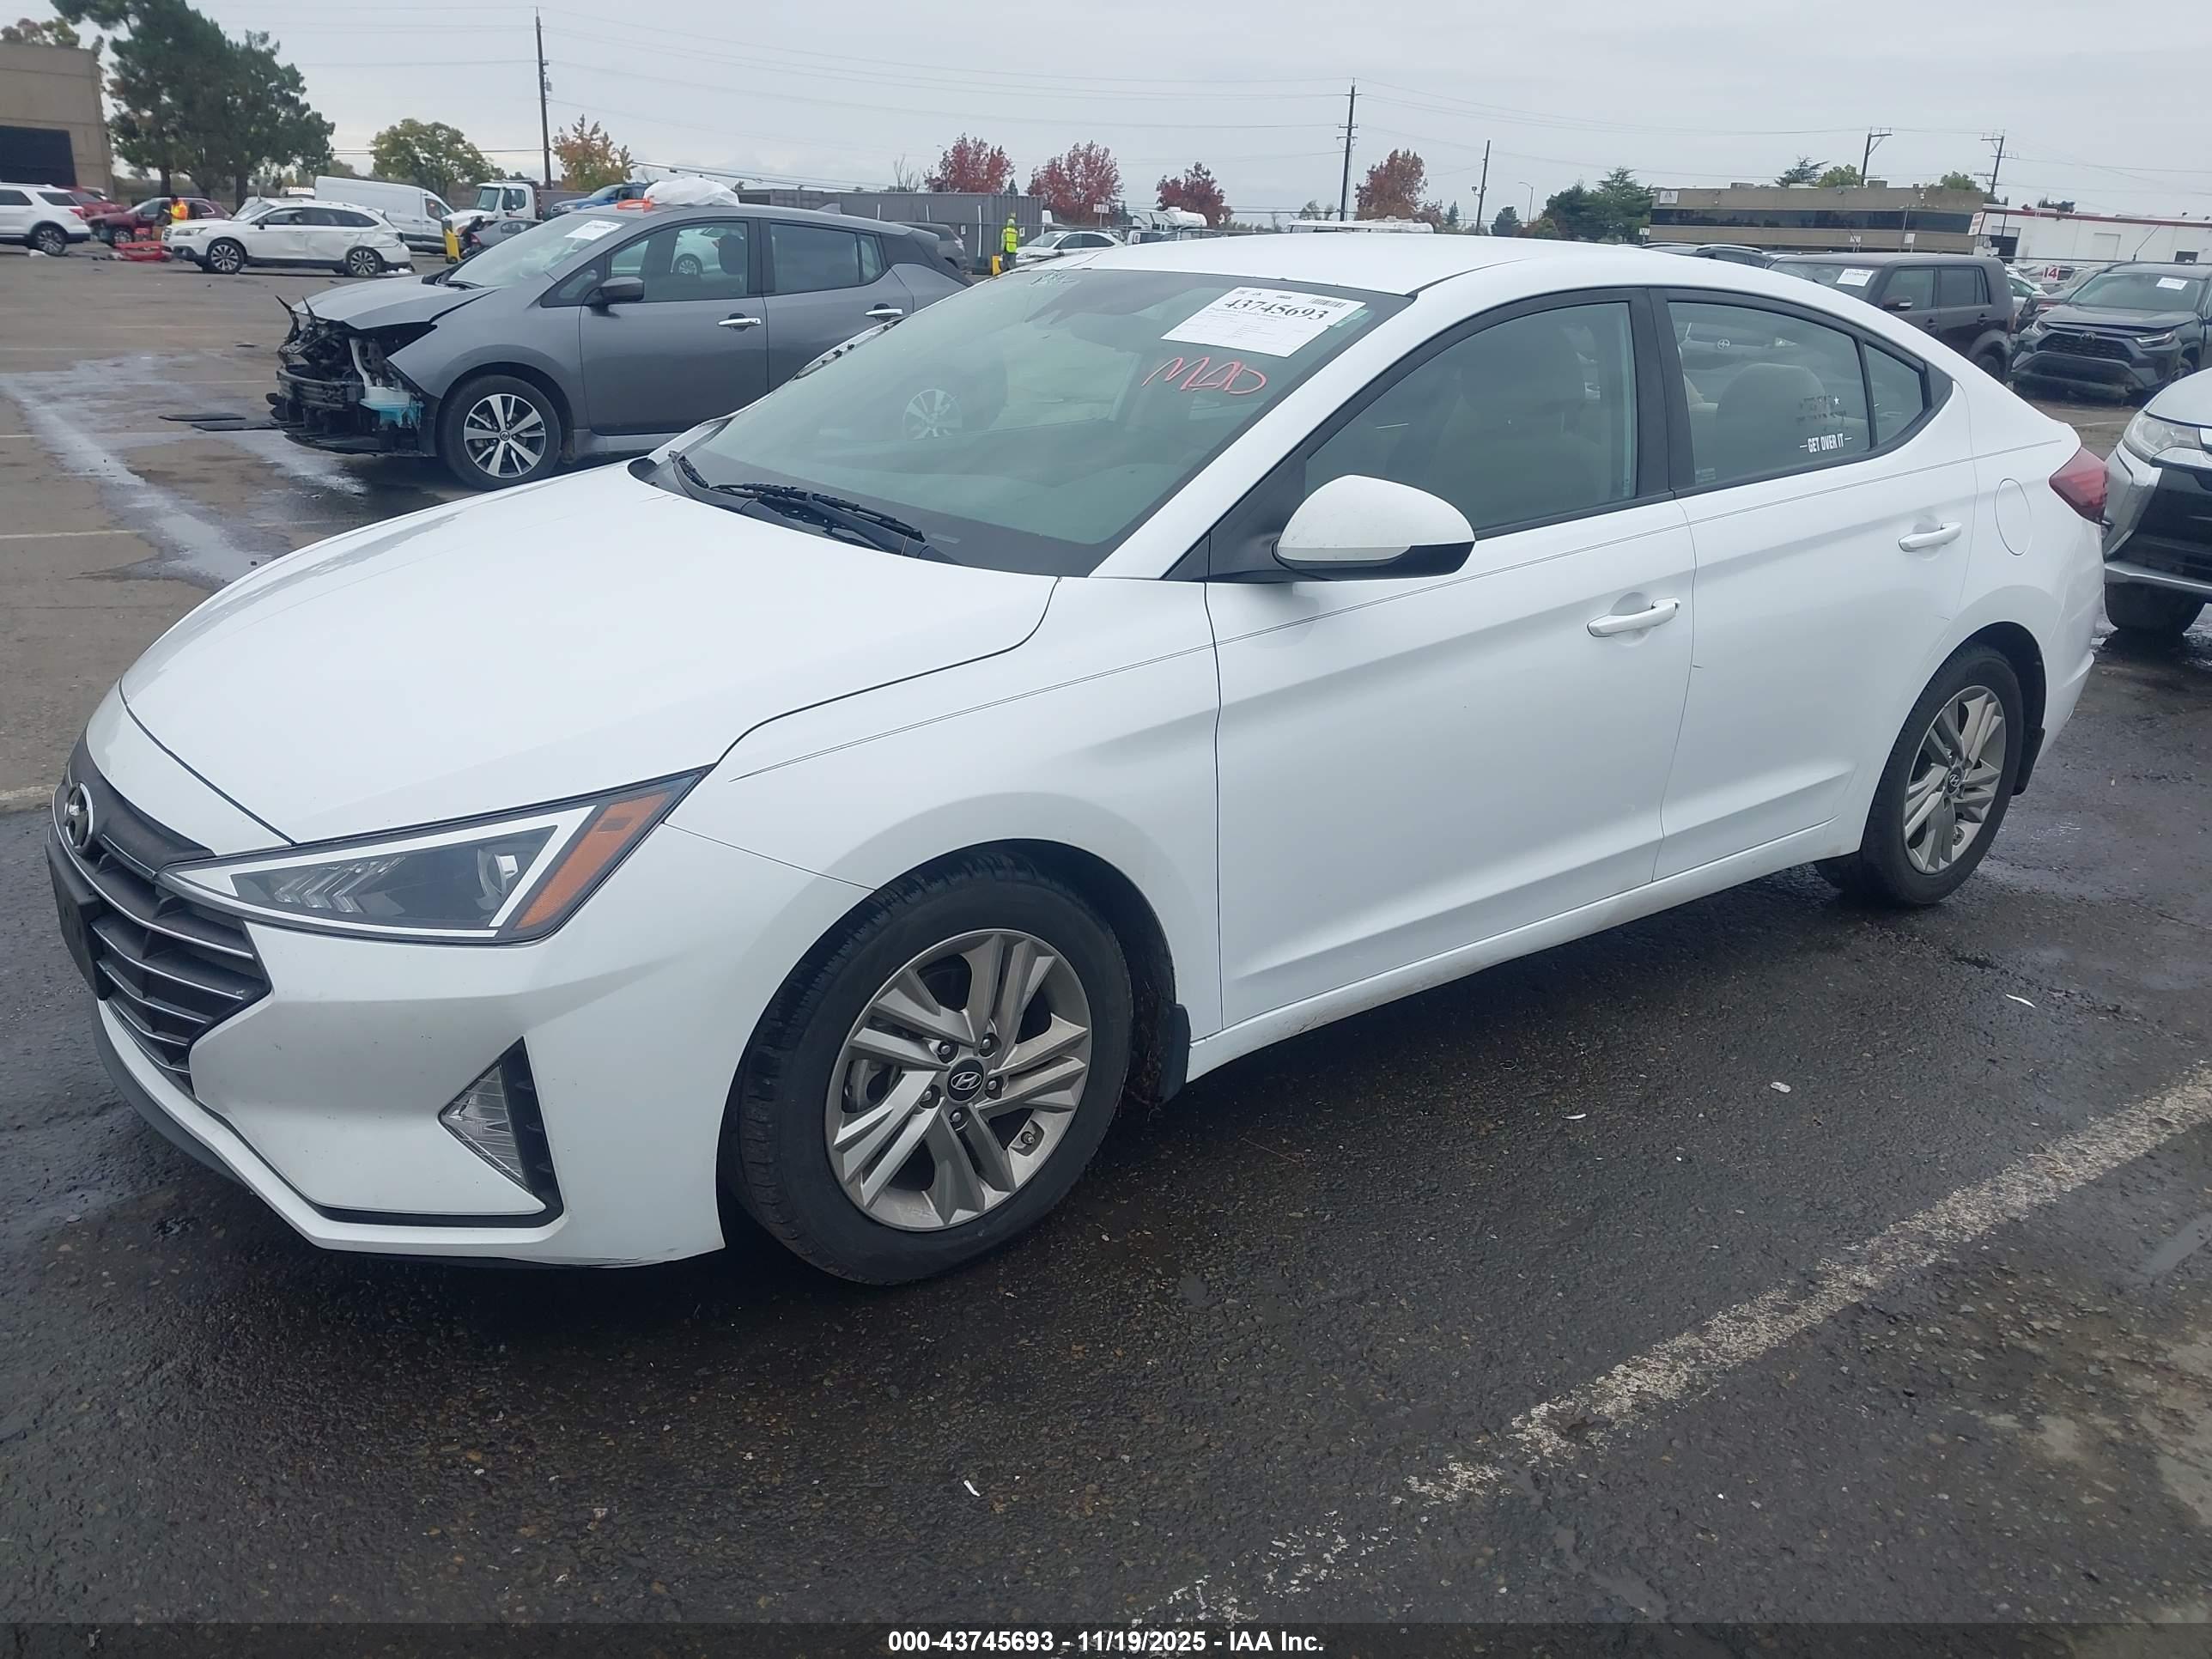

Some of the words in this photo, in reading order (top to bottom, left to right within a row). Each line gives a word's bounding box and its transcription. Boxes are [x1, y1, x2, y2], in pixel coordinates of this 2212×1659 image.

[2044, 267, 2057, 279] 14
[1224, 299, 1329, 320] 43745693
[1808, 437, 1820, 453] GET
[1820, 434, 1838, 450] OVER
[1838, 433, 1844, 447] IT
